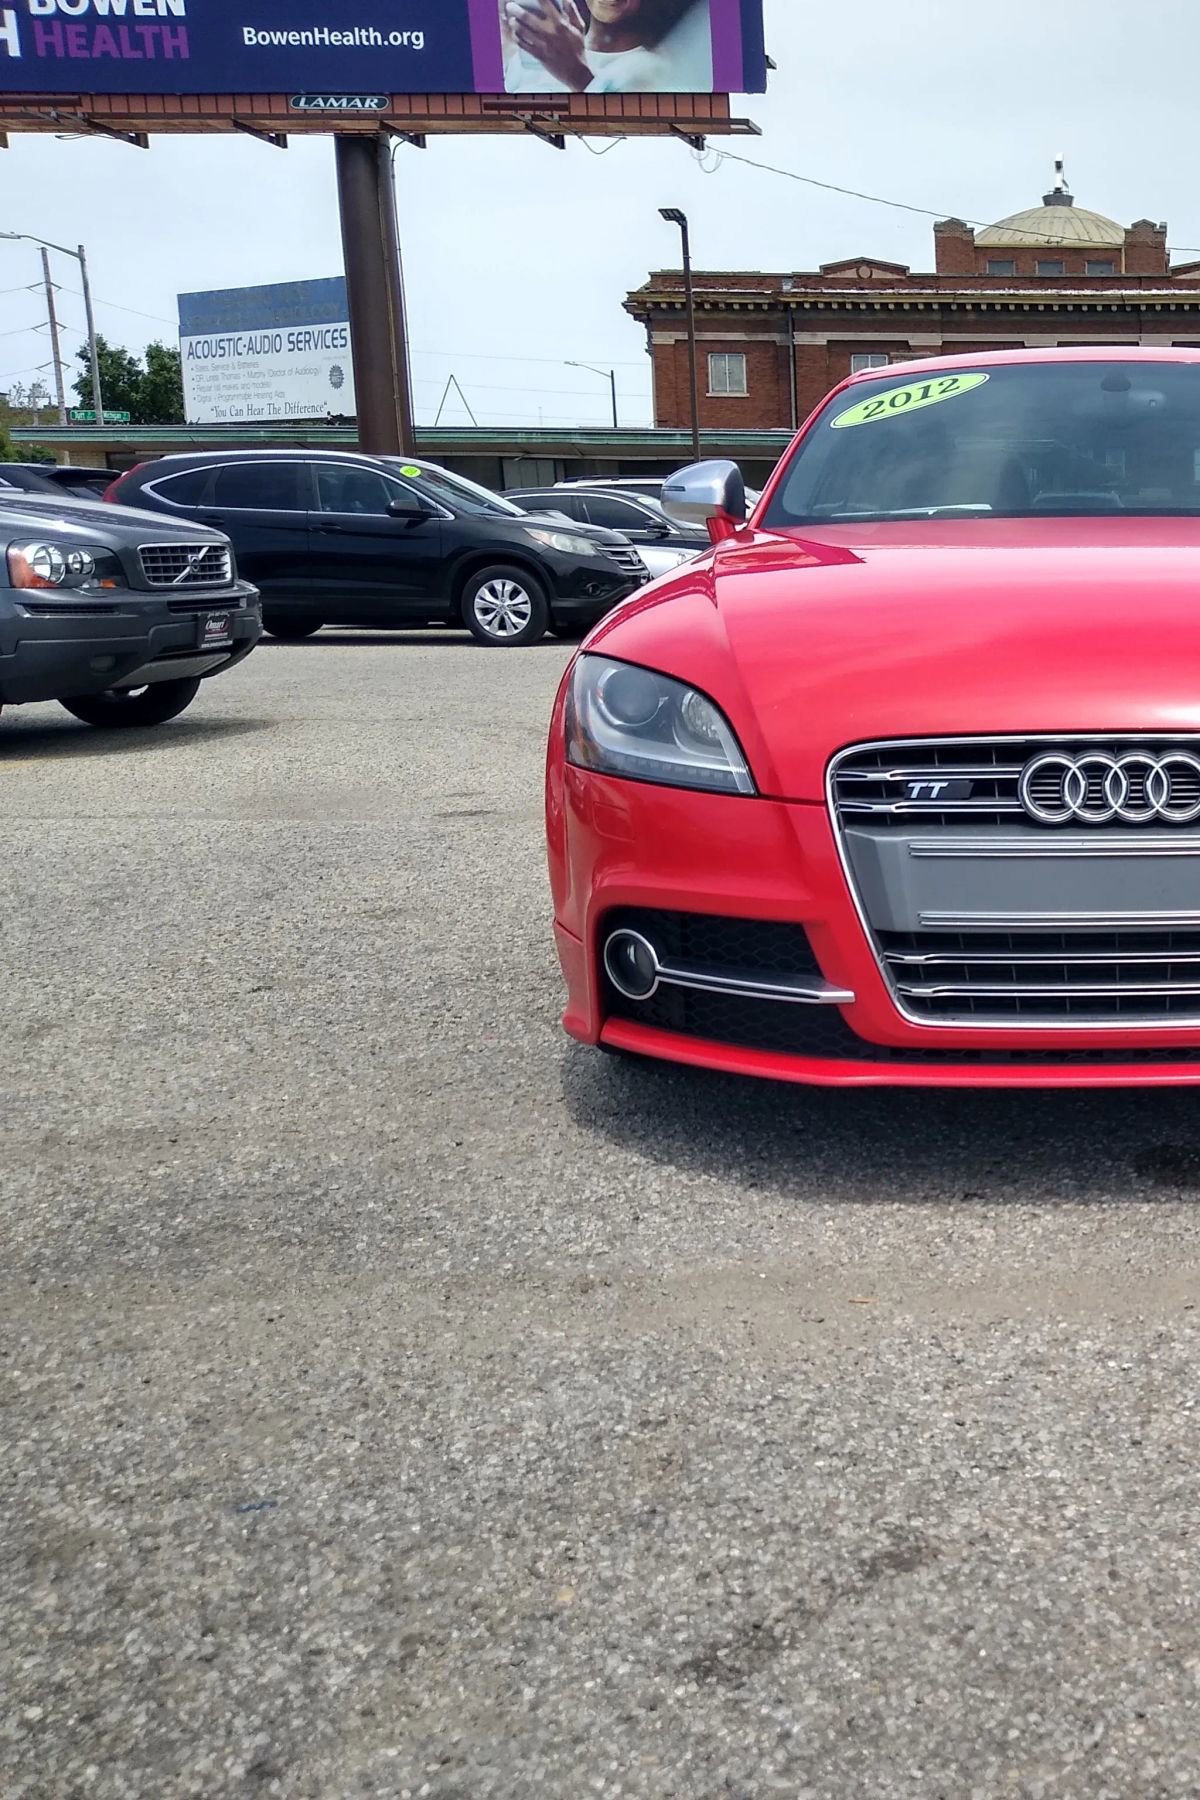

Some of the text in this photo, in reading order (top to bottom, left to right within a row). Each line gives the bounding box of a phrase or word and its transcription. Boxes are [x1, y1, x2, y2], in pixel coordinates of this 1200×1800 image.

[33, 20, 190, 59] HEALTH
[242, 26, 425, 50] BowenHealth.org
[298, 96, 379, 109] LAMAR
[287, 328, 347, 352] SERVICES
[229, 404, 244, 418] Can
[247, 403, 265, 417] Hear
[267, 402, 282, 416] The
[862, 378, 961, 420] 2012
[907, 782, 949, 799] TT
